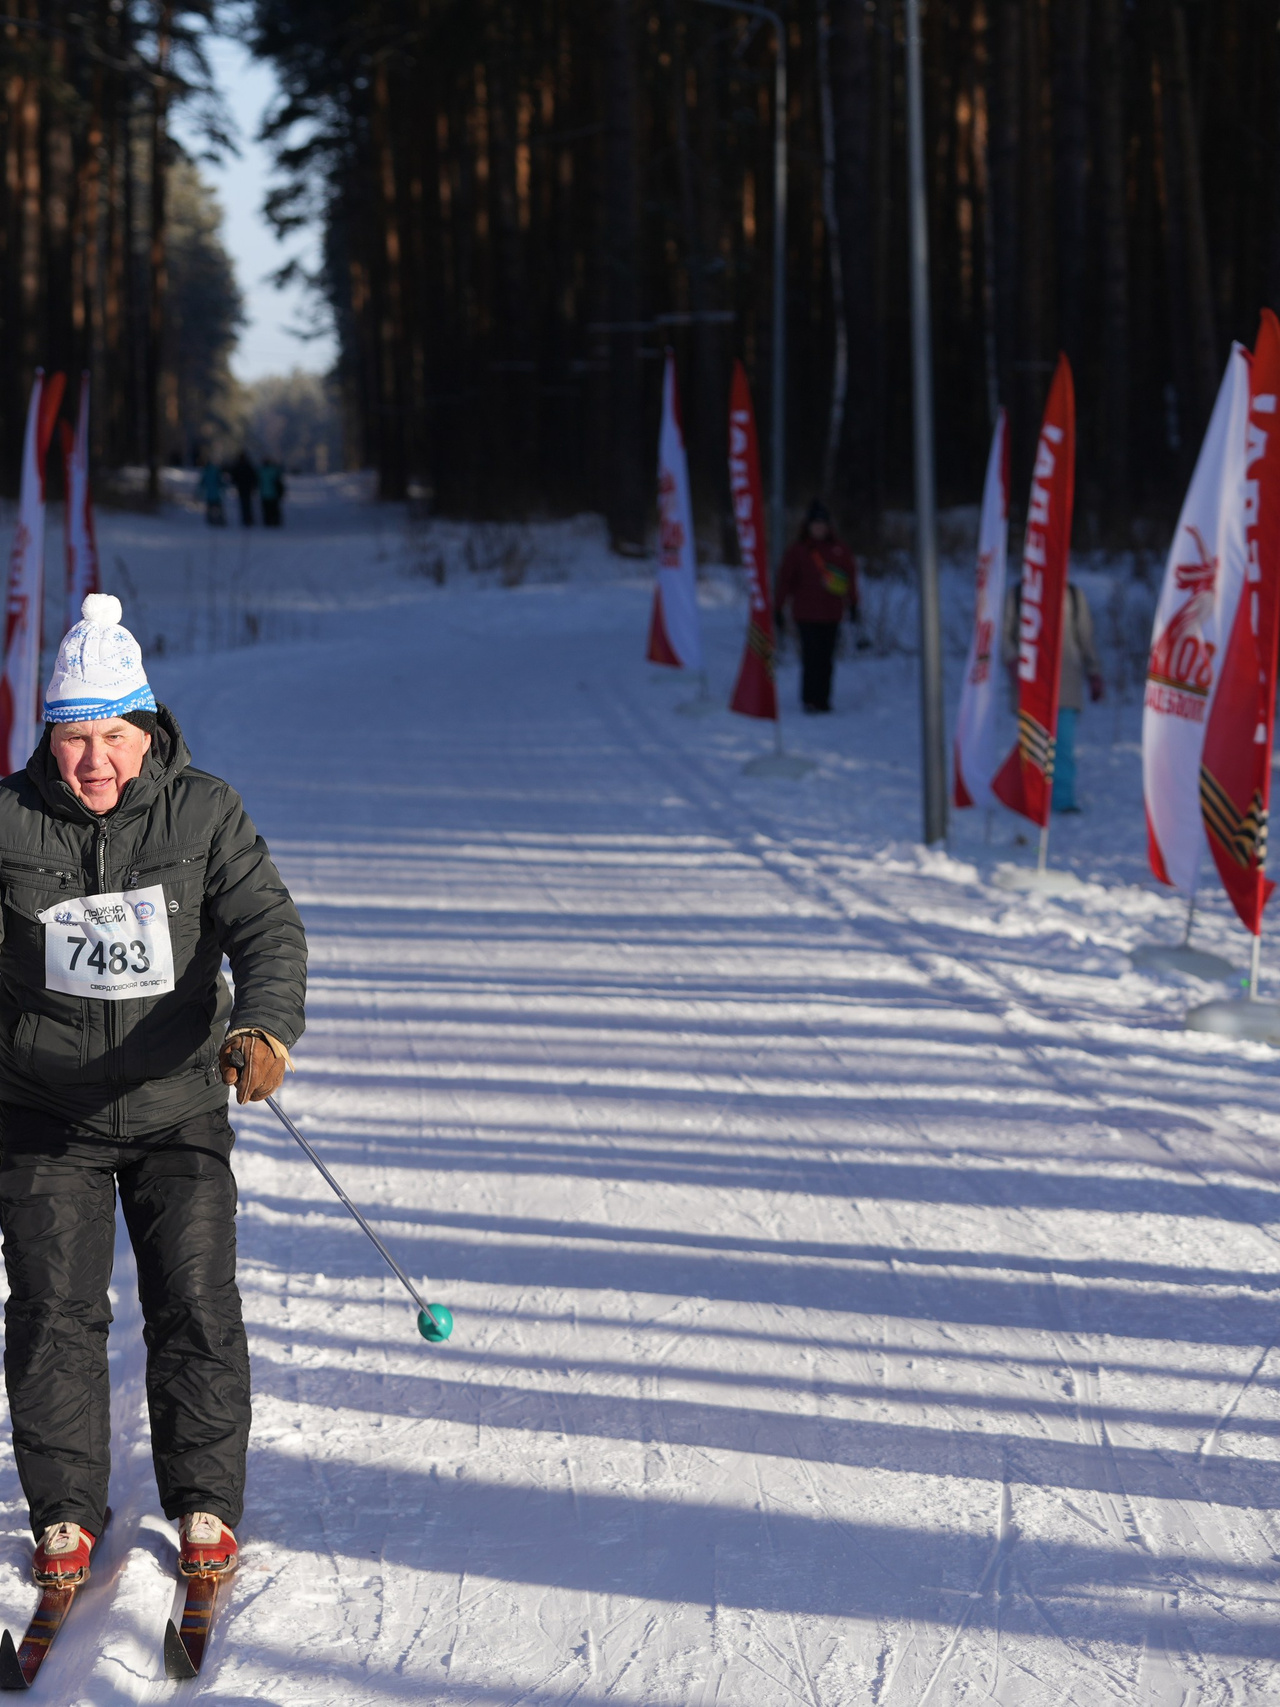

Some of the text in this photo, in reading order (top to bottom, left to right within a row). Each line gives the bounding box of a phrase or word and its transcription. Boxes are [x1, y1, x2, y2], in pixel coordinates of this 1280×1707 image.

[84, 905, 123, 919] ЛЫЖНЯ
[67, 936, 150, 975] 7483
[90, 981, 138, 992] СВЕРДЛОВСКАЯ
